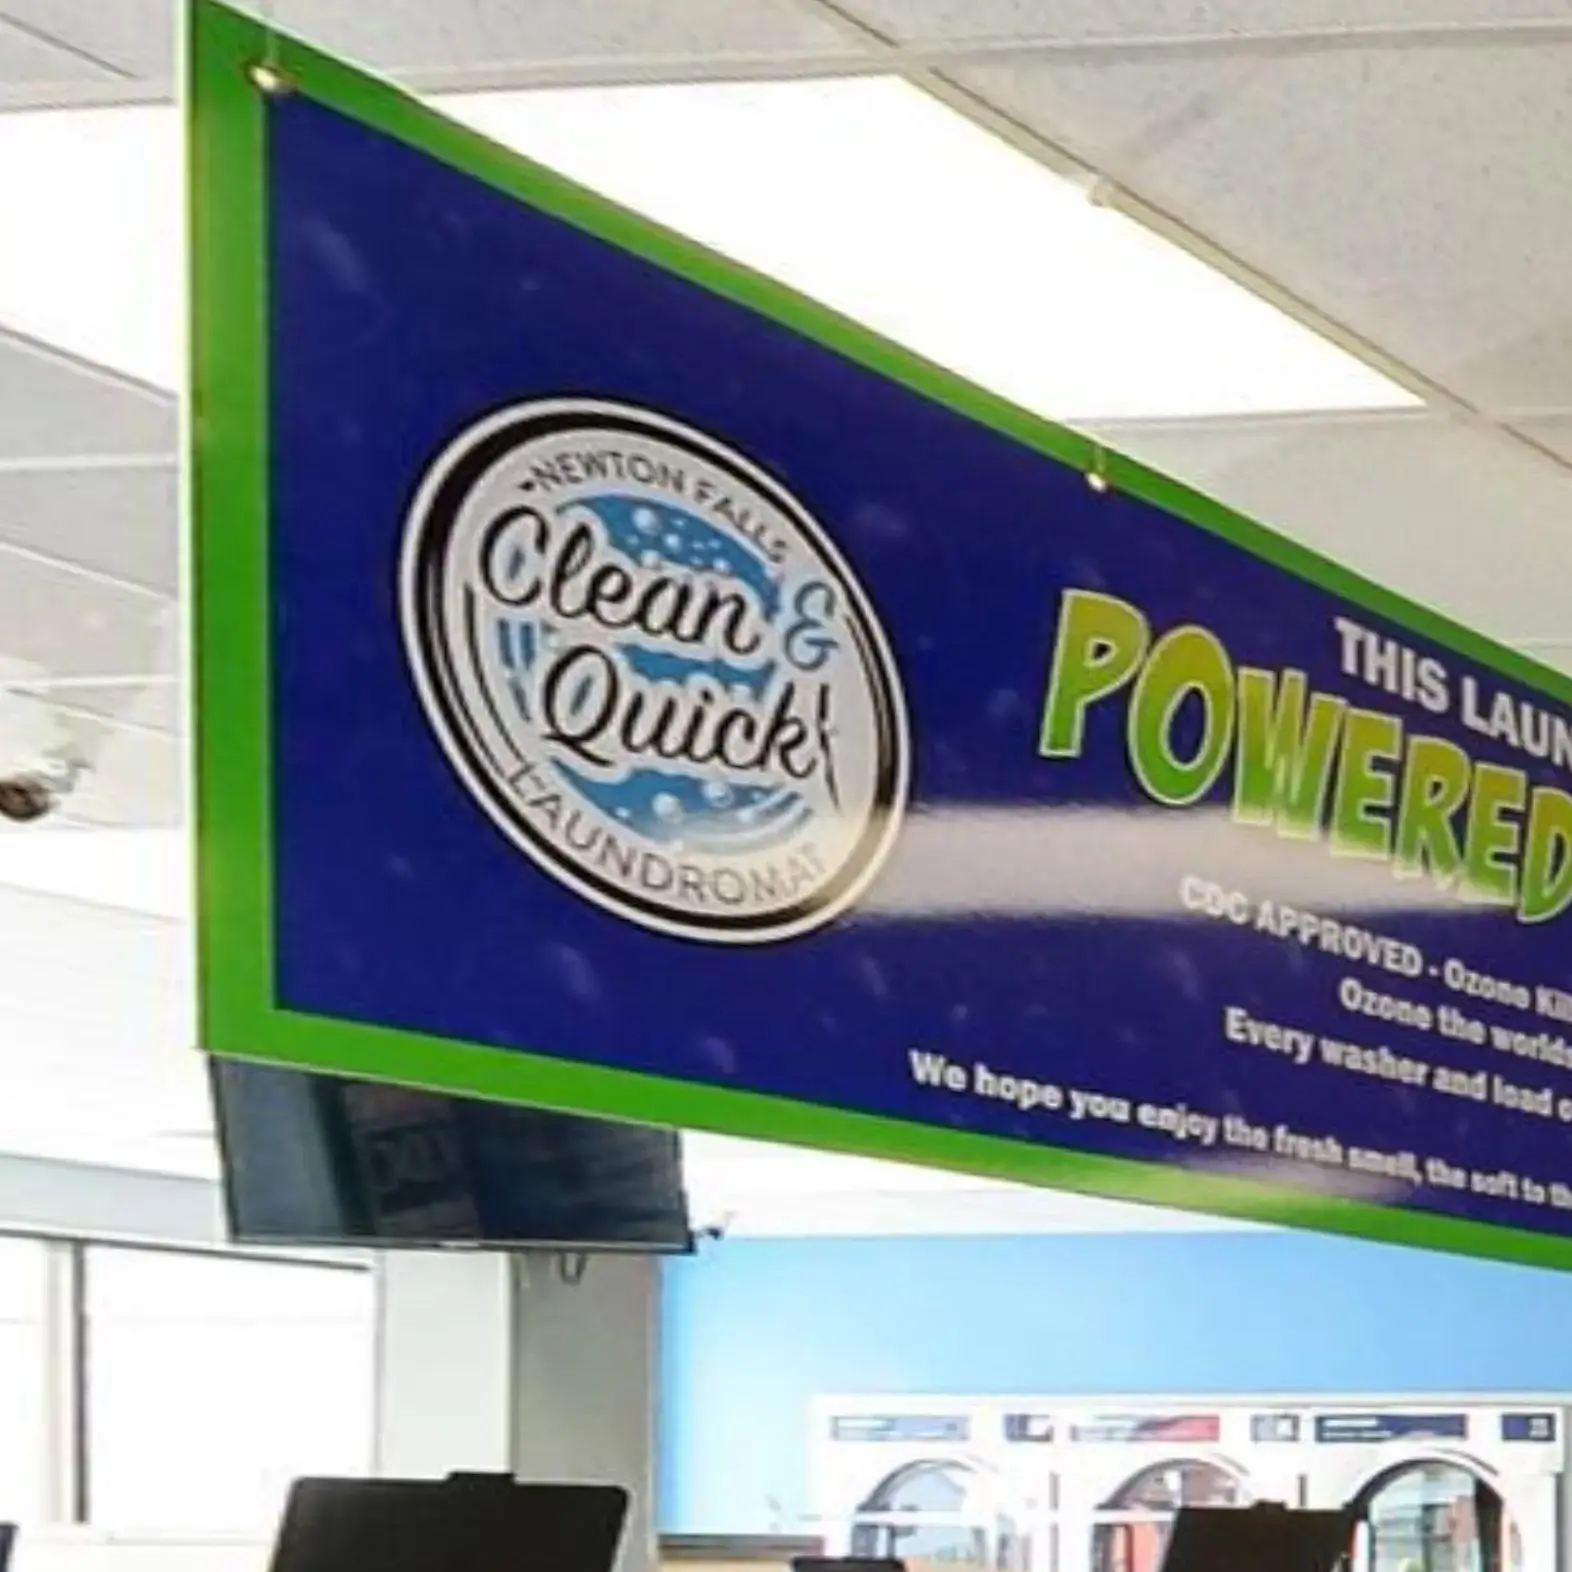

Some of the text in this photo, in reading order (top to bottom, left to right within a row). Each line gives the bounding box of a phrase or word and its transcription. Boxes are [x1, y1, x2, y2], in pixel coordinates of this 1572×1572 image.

[527, 450, 789, 564] NEWTON FALLS
[480, 505, 841, 671] Clean &
[1334, 616, 1449, 713] THIS
[508, 762, 829, 908] LAUNDROMAT
[1180, 876, 1250, 925] CDC
[1255, 901, 1423, 977] APPROVED
[1444, 958, 1531, 1010] Ozone
[1225, 1006, 1315, 1066] Every
[1320, 1036, 1428, 1087] washer
[1433, 1066, 1488, 1102] and
[1493, 1075, 1552, 1117] load
[1338, 976, 1433, 1032] Ozone
[1437, 1004, 1487, 1046] the
[908, 1048, 967, 1091] We
[972, 1061, 1064, 1112] hope
[1068, 1088, 1131, 1123] you
[1137, 1101, 1220, 1147] enjoy
[1222, 1114, 1269, 1151] the
[1273, 1124, 1344, 1165] fresh
[1425, 1157, 1467, 1190] the
[1470, 1170, 1520, 1199] soft
[1521, 1176, 1546, 1204] to
